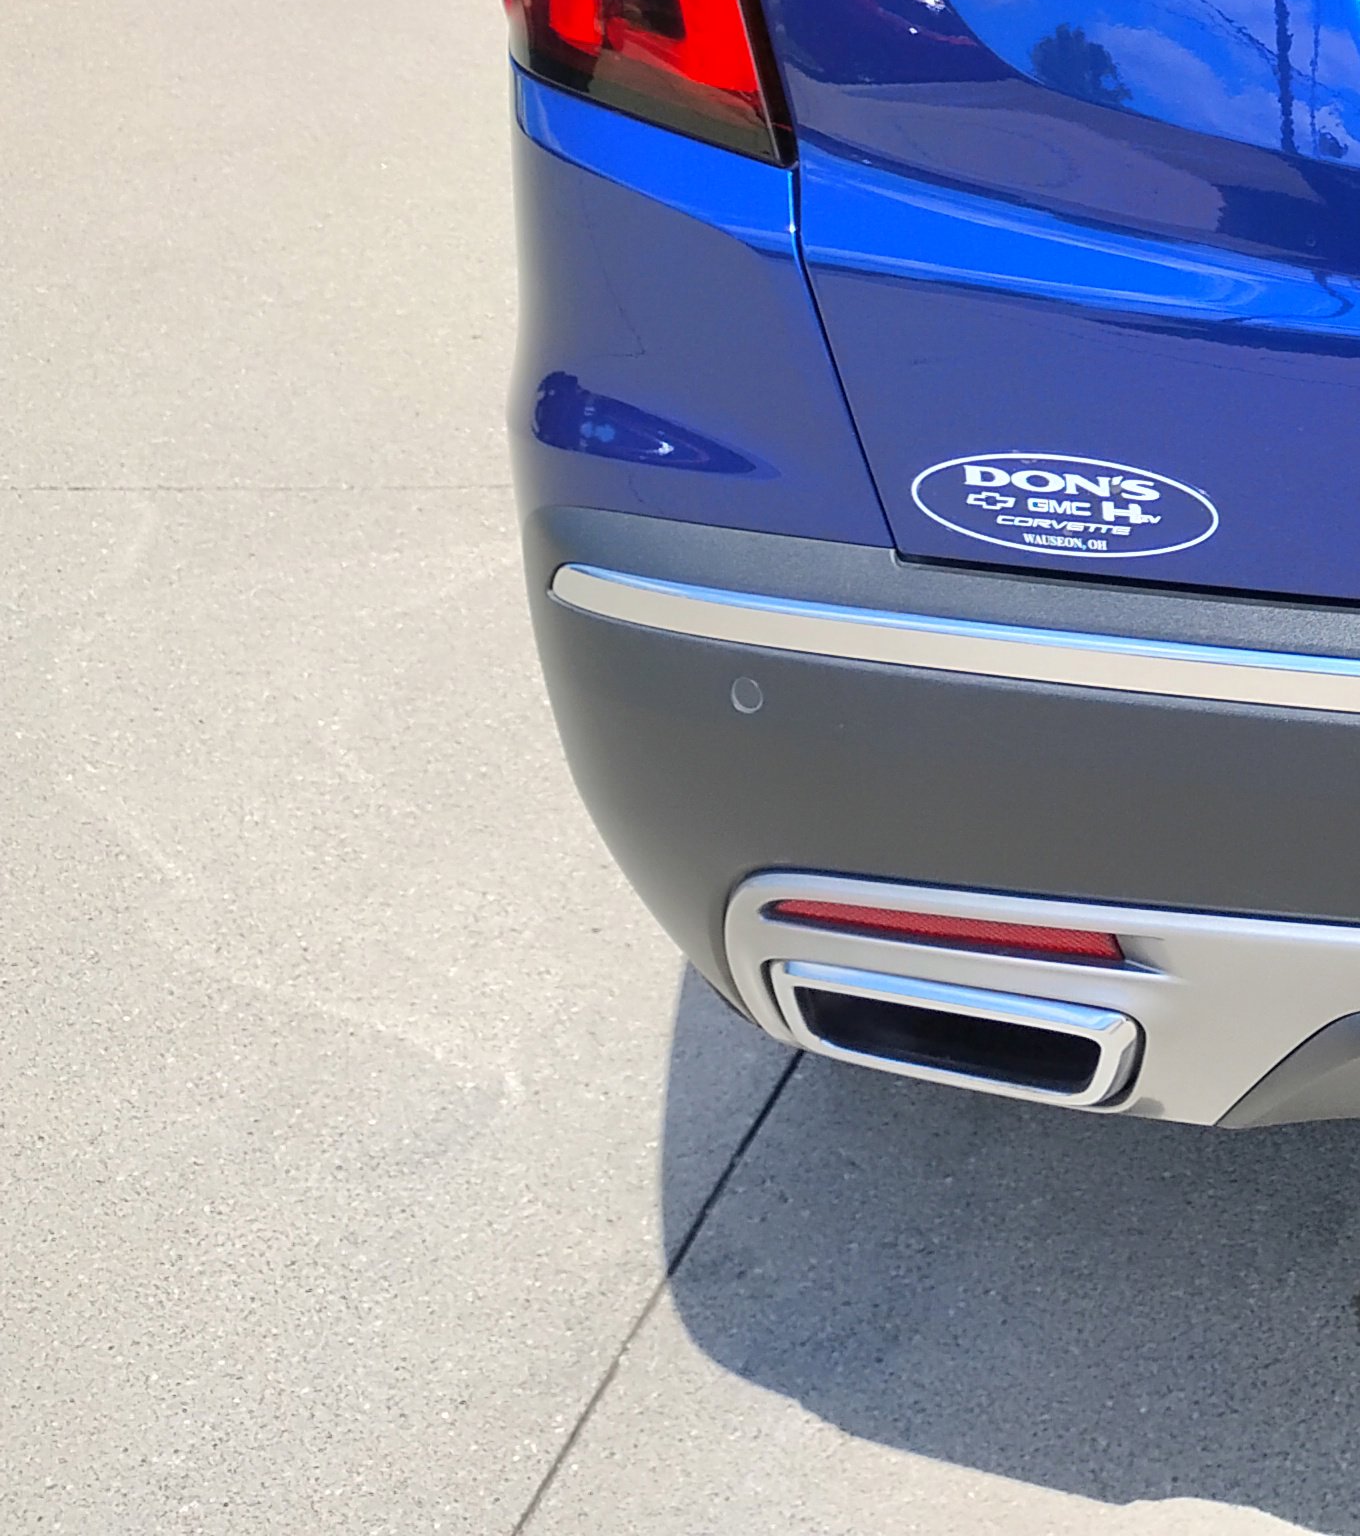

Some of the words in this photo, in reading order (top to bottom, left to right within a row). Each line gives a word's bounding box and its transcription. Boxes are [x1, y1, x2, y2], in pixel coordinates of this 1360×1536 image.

[963, 465, 1160, 501] DON'S
[1027, 498, 1091, 516] GMC
[996, 515, 1131, 535] CORVETTE
[1022, 533, 1087, 550] WAUSEON,
[1088, 539, 1108, 551] OH
